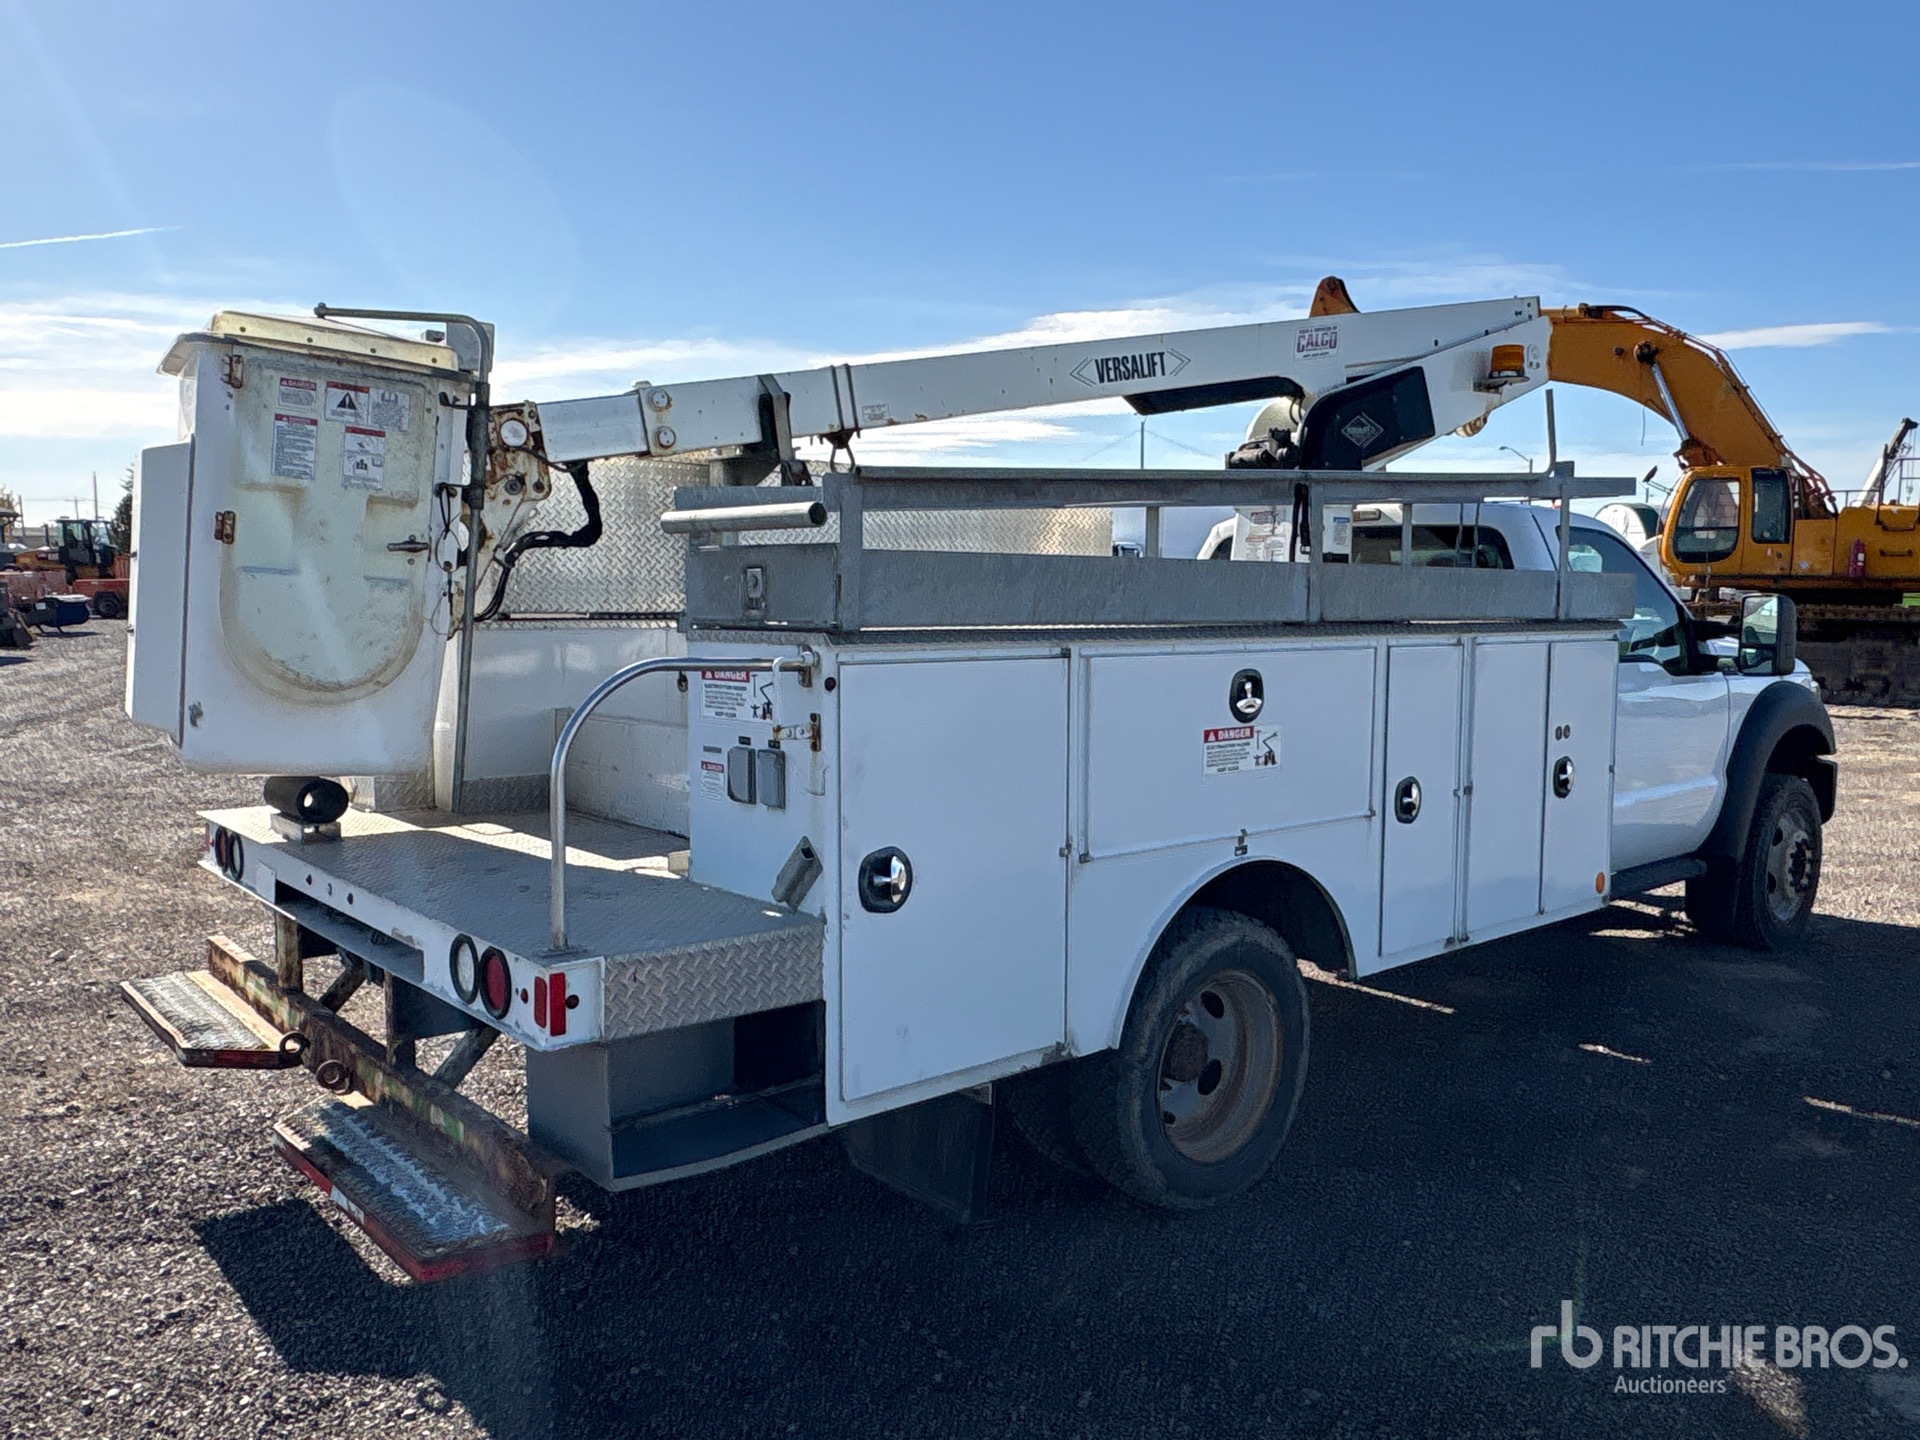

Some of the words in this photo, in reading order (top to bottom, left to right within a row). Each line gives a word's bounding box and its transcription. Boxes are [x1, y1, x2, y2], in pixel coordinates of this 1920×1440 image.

[1297, 331, 1337, 353] CALCO
[1095, 352, 1165, 384] VERSALIFT
[714, 671, 747, 680] DANGER
[1218, 728, 1251, 740] DANGER
